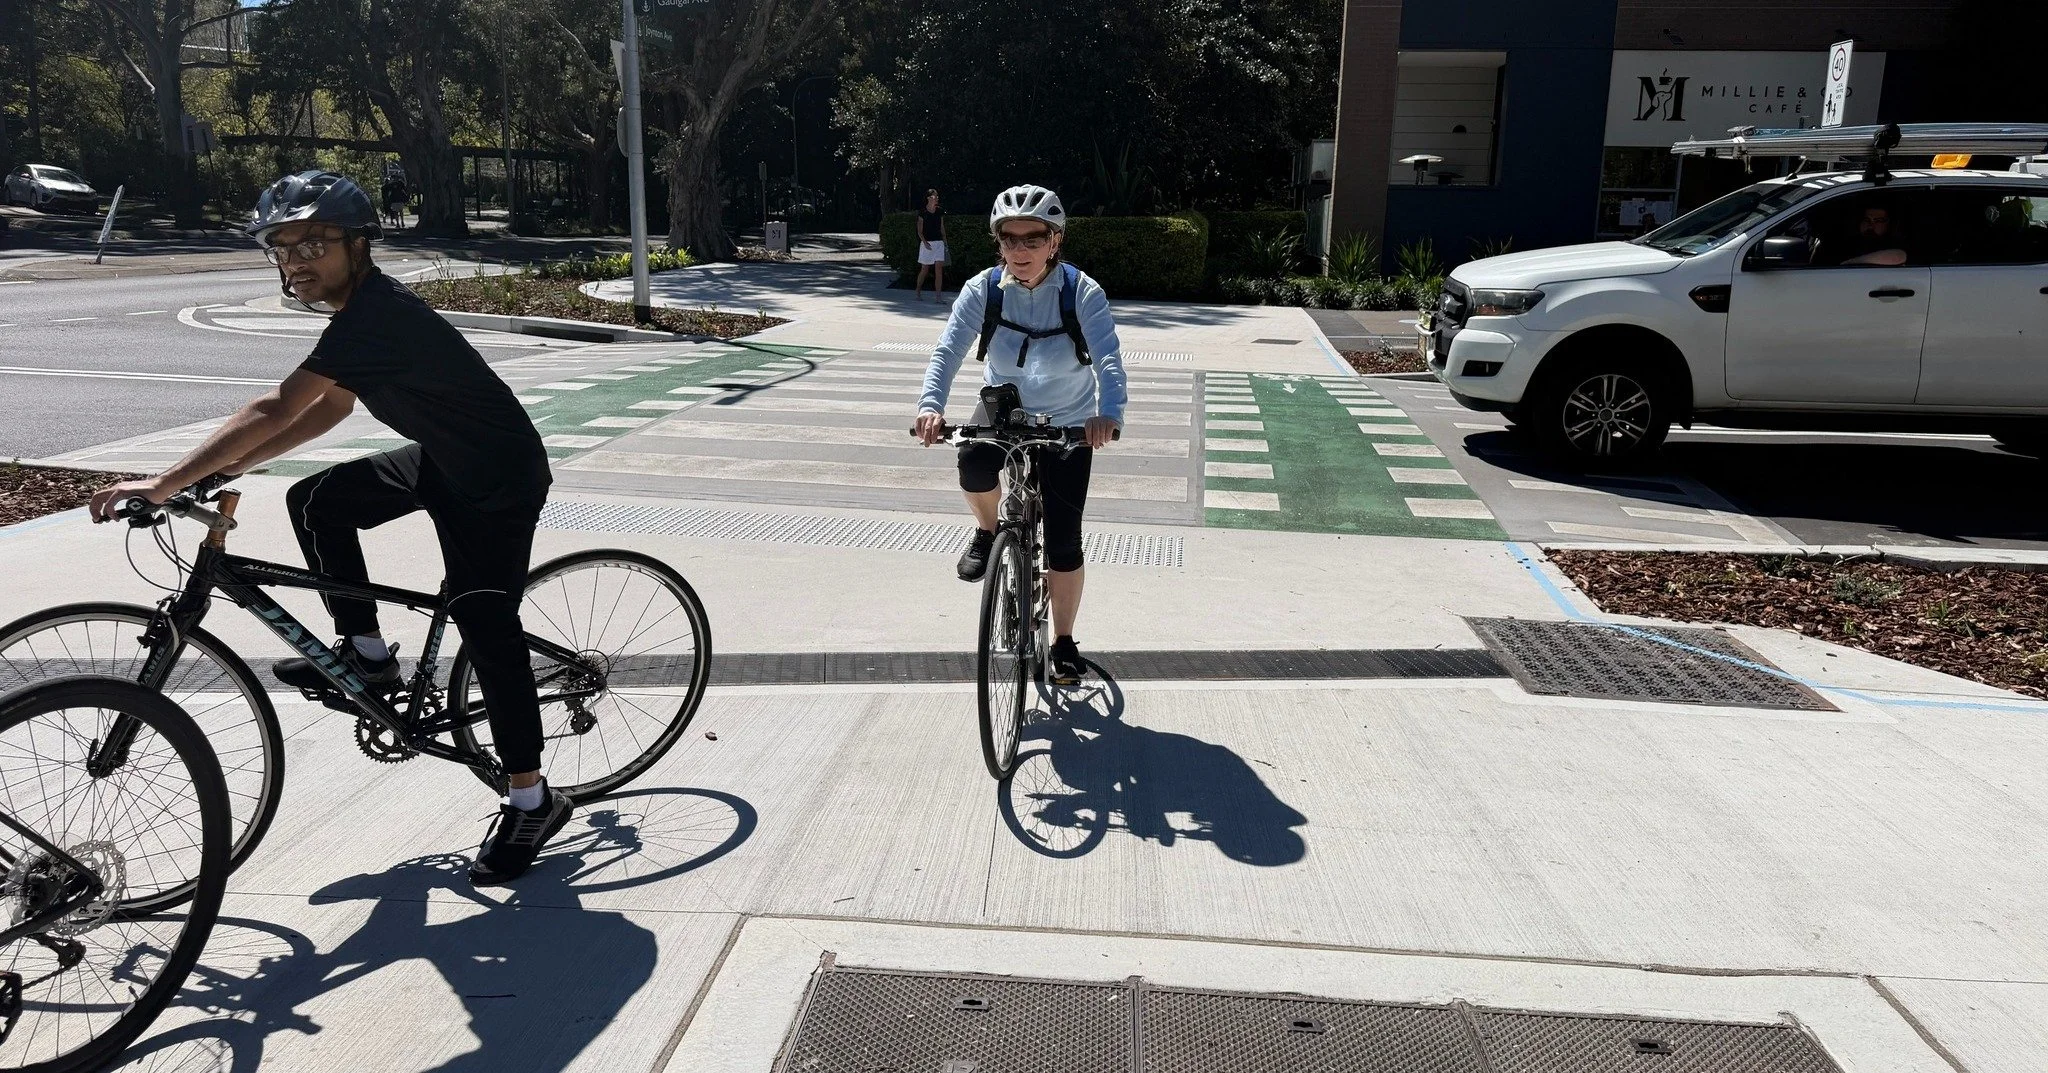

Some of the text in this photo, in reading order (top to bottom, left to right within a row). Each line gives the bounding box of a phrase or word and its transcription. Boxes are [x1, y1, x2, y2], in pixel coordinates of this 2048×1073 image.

[1835, 57, 1844, 72] 40
[1701, 86, 1786, 98] MILLIE
[1797, 87, 1807, 98] &
[1749, 100, 1801, 113] CAFÉ
[251, 604, 366, 693] JAMIS
[425, 624, 444, 674] AMIS
[143, 646, 165, 684] AMIS
